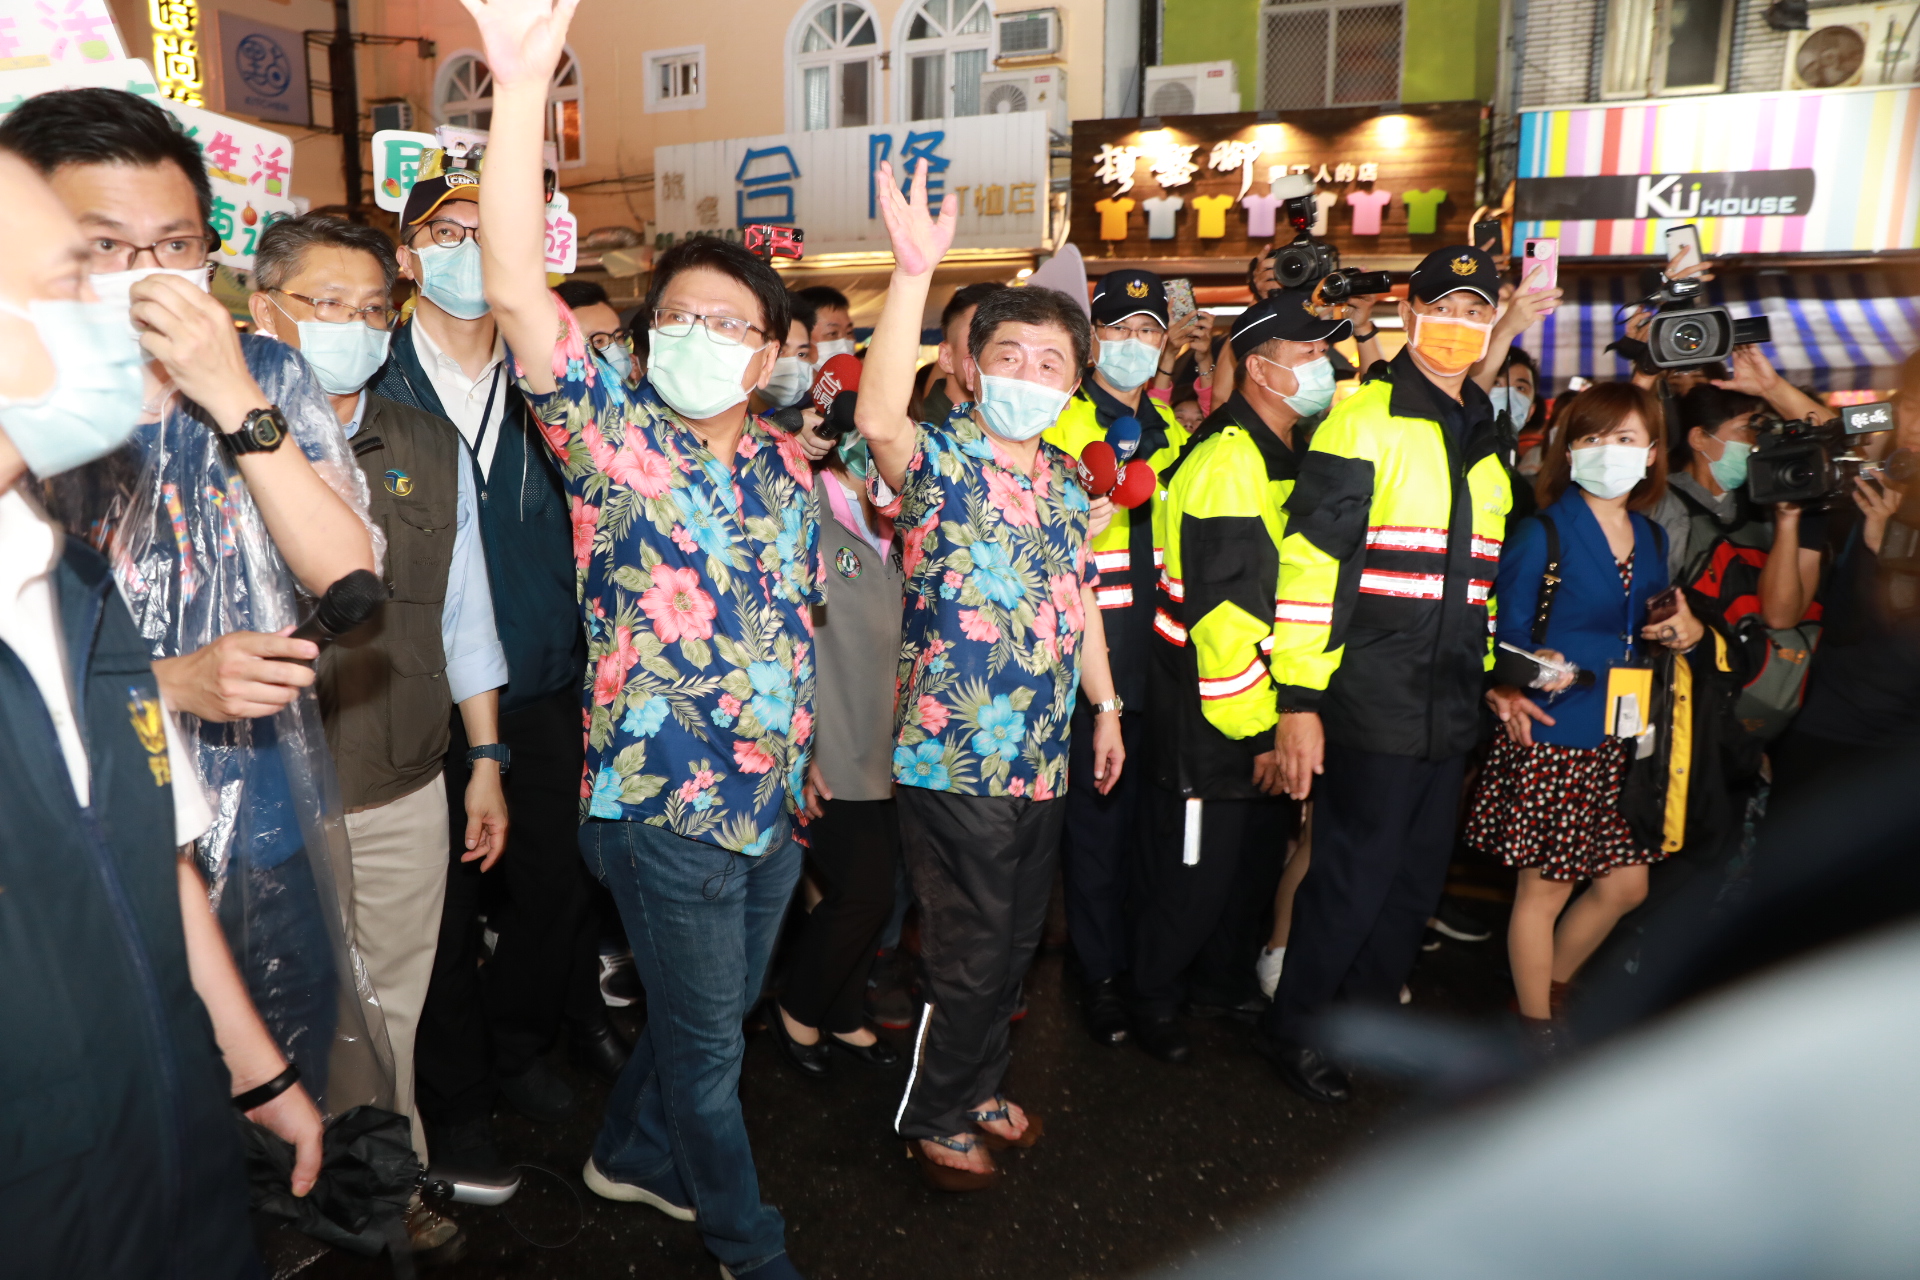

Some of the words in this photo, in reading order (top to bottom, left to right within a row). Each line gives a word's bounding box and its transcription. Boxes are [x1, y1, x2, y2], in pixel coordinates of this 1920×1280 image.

[190, 127, 289, 197] 生活
[955, 182, 1036, 216] T恤店
[1701, 196, 1797, 216] HOUSE
